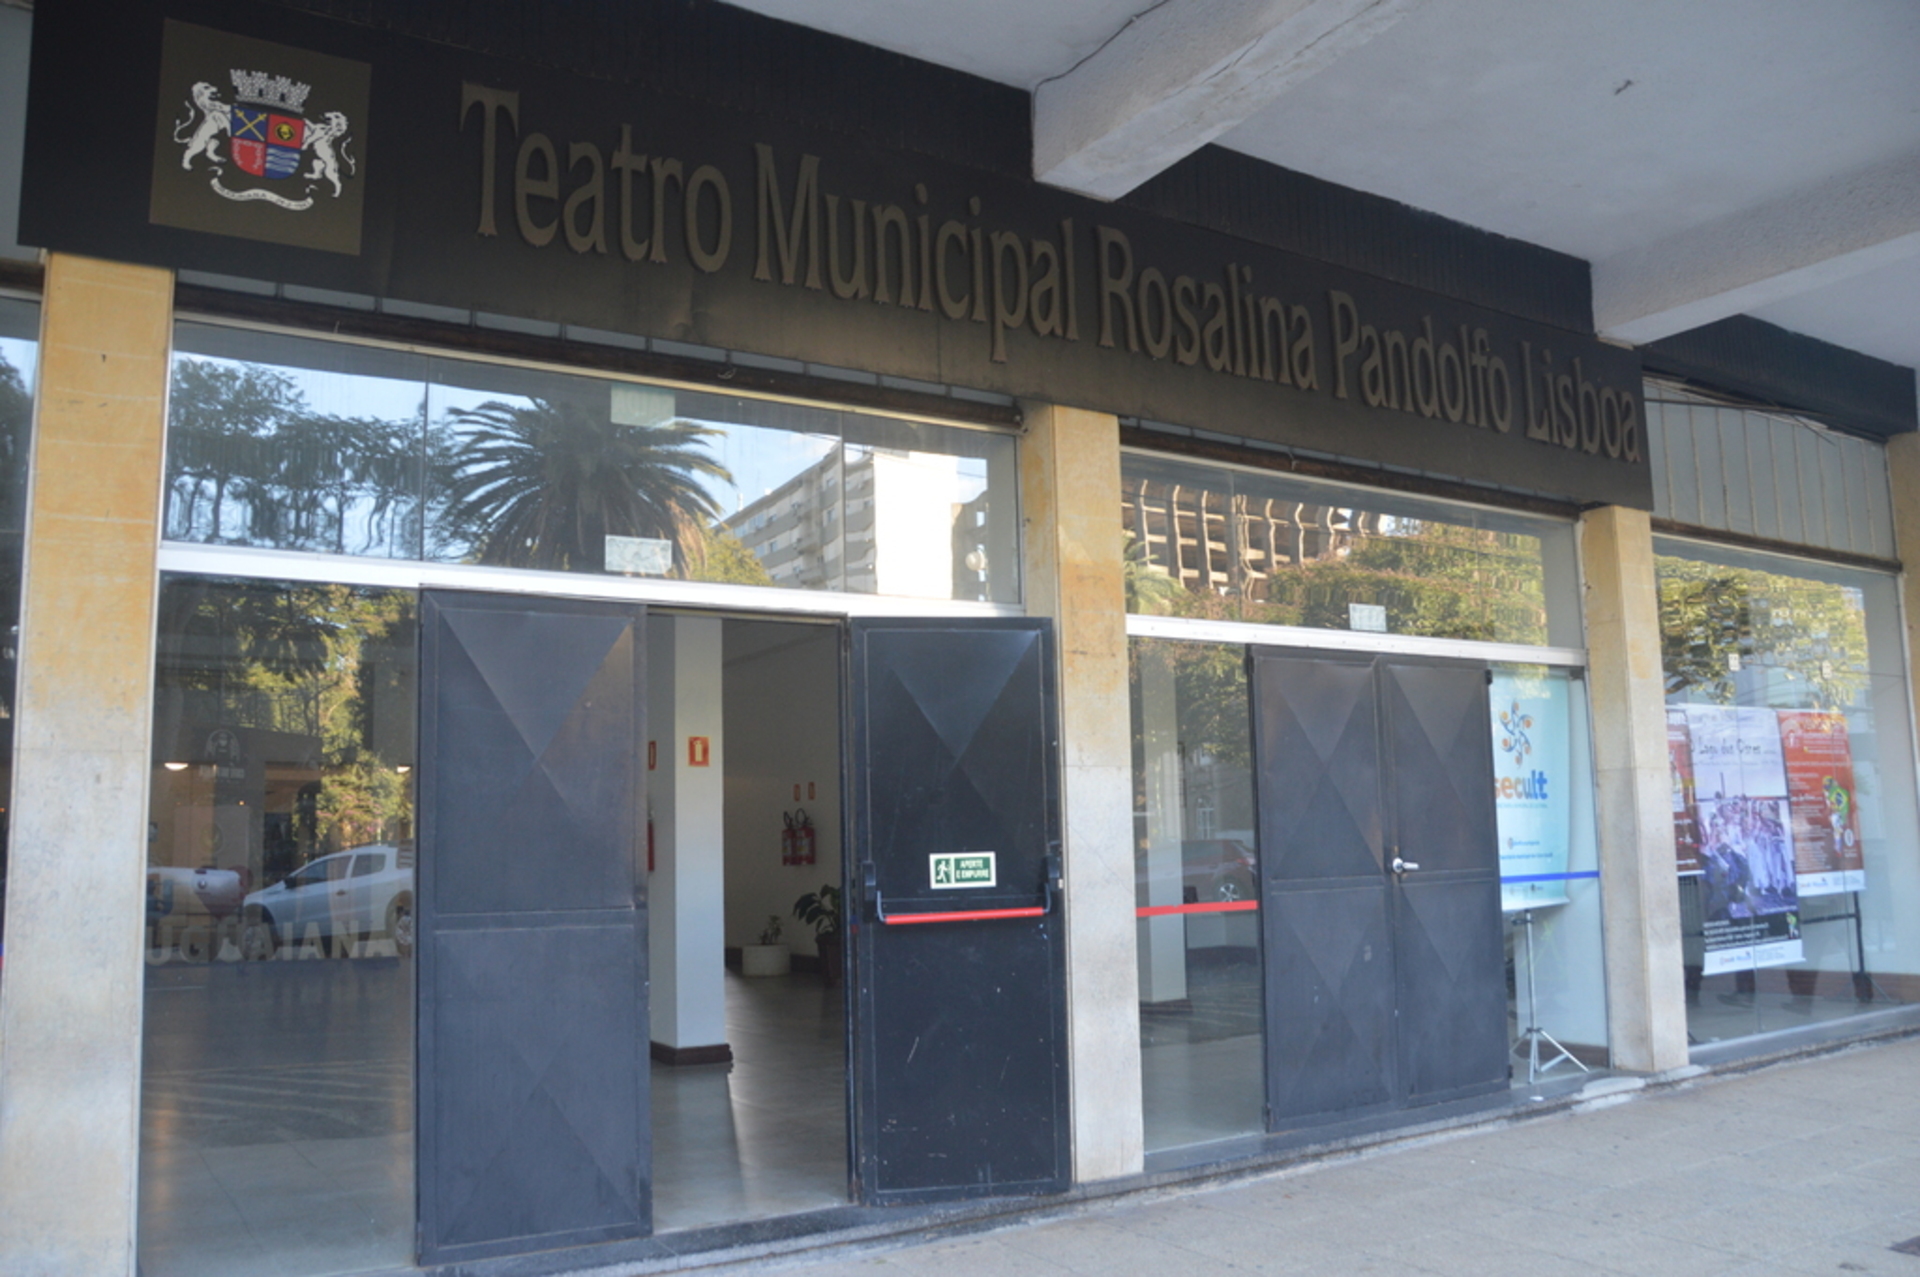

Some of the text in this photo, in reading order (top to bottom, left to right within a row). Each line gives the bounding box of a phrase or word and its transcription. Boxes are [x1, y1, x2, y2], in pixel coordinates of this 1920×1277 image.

[459, 80, 1641, 463] Teatro Municipal Rosalina Pandolfo Lisboa
